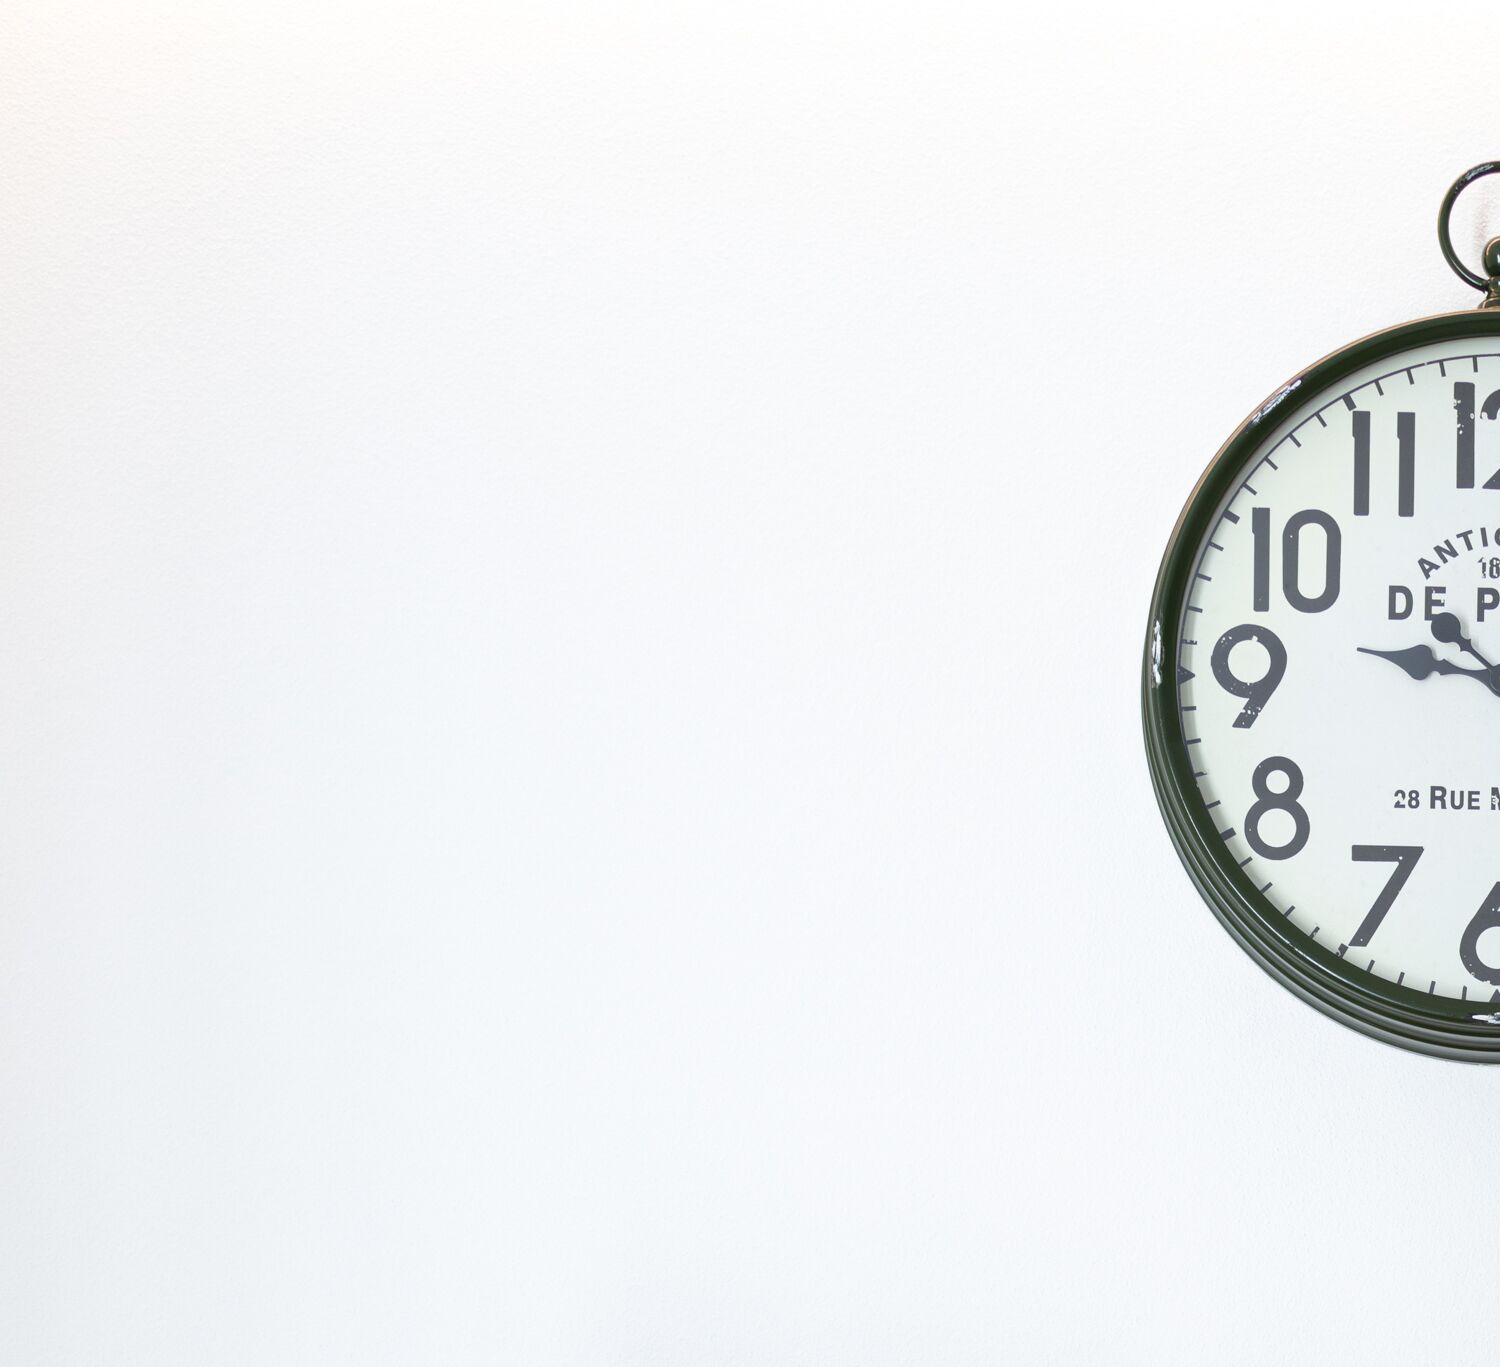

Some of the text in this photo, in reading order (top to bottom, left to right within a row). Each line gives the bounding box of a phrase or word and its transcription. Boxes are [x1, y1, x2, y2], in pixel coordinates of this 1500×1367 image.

[1353, 411, 1415, 517] 11
[1252, 508, 1342, 613] 10
[1388, 585, 1446, 621] DE
[1211, 624, 1288, 729] 9
[1243, 756, 1310, 861] 8
[1394, 789, 1420, 809] 28
[1350, 845, 1424, 947] 7
